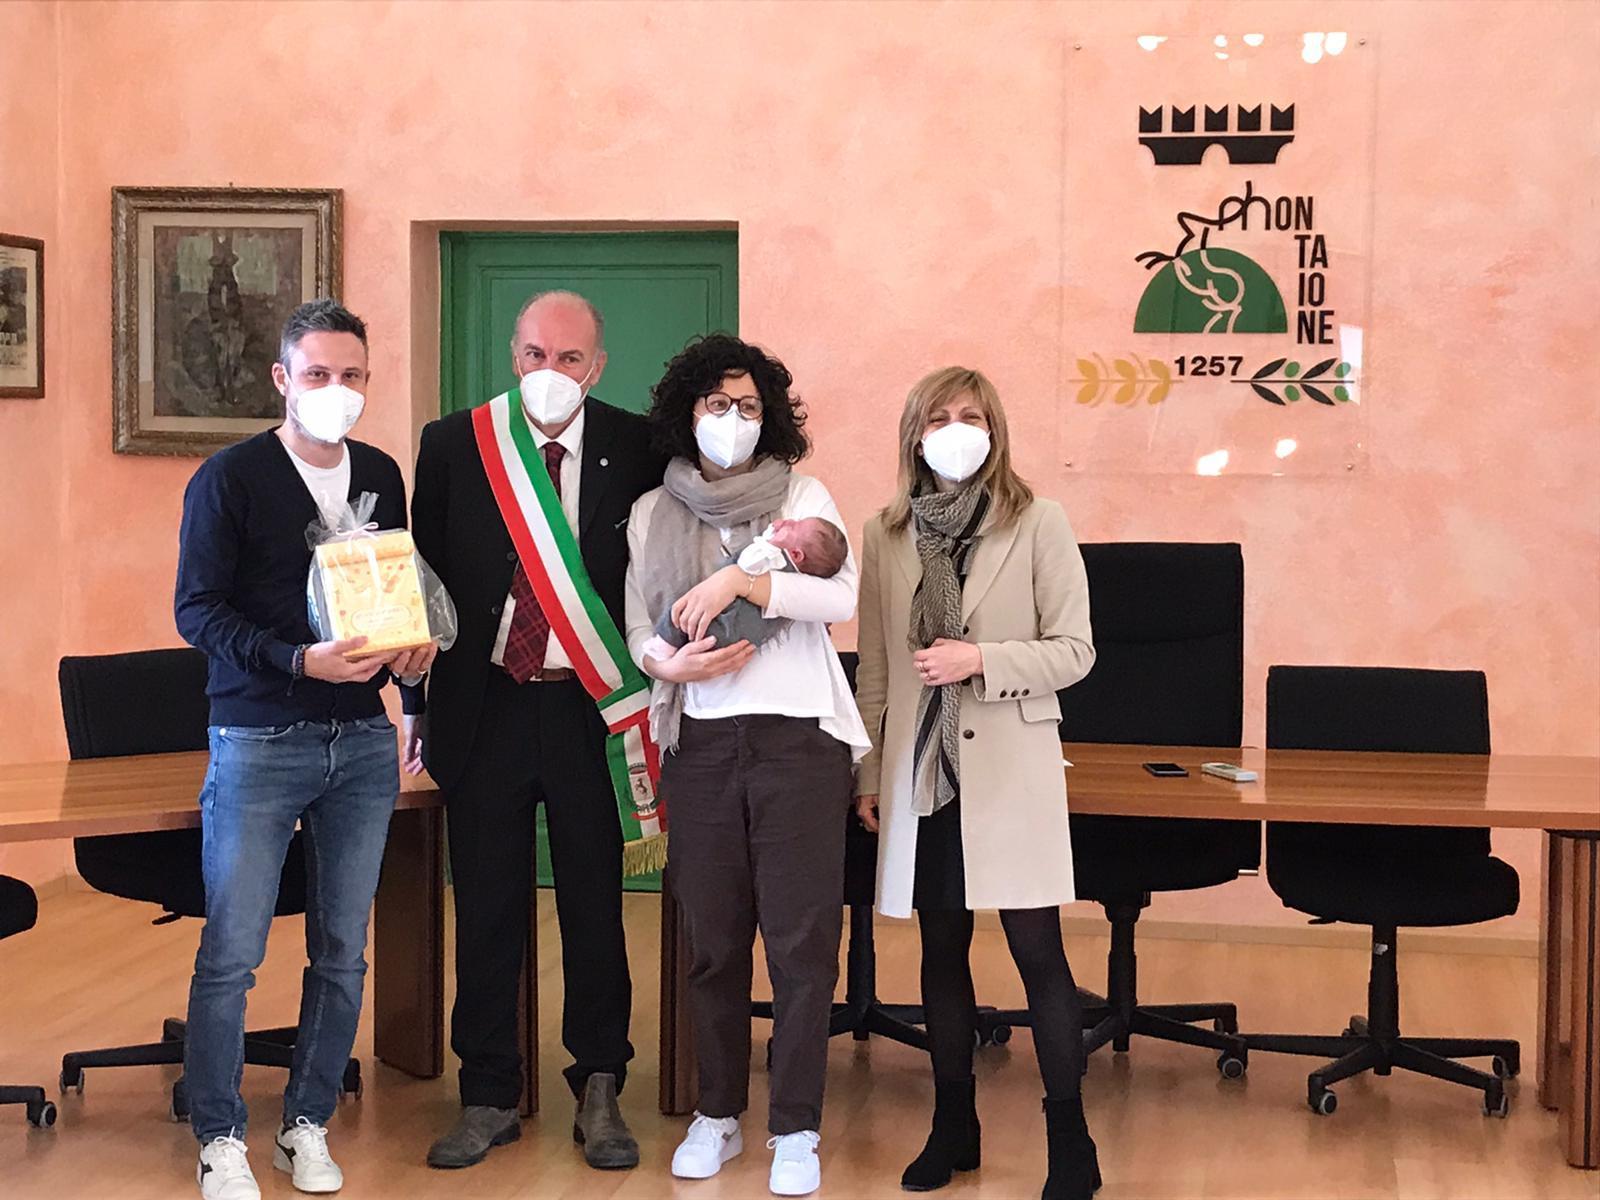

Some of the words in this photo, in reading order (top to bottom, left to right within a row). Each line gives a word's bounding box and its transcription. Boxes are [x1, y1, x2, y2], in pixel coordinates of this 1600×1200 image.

[1294, 234, 1328, 268] TA
[1298, 272, 1325, 306] IO
[1297, 310, 1334, 344] NE
[1174, 356, 1243, 376] 1257
